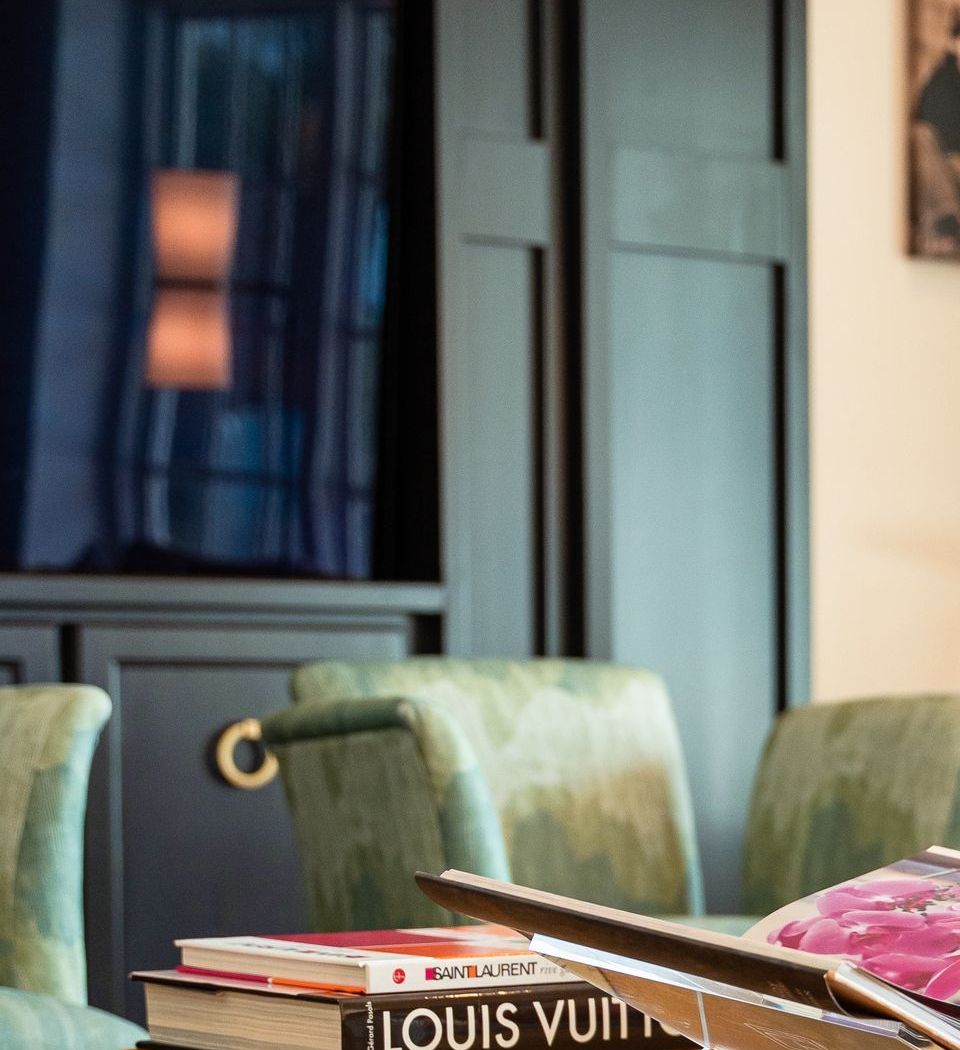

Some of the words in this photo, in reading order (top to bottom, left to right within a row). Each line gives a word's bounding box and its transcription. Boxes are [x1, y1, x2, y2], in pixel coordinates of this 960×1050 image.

[434, 965, 471, 981] SAINT
[474, 962, 538, 978] LAURENT
[532, 997, 682, 1047] VUIT
